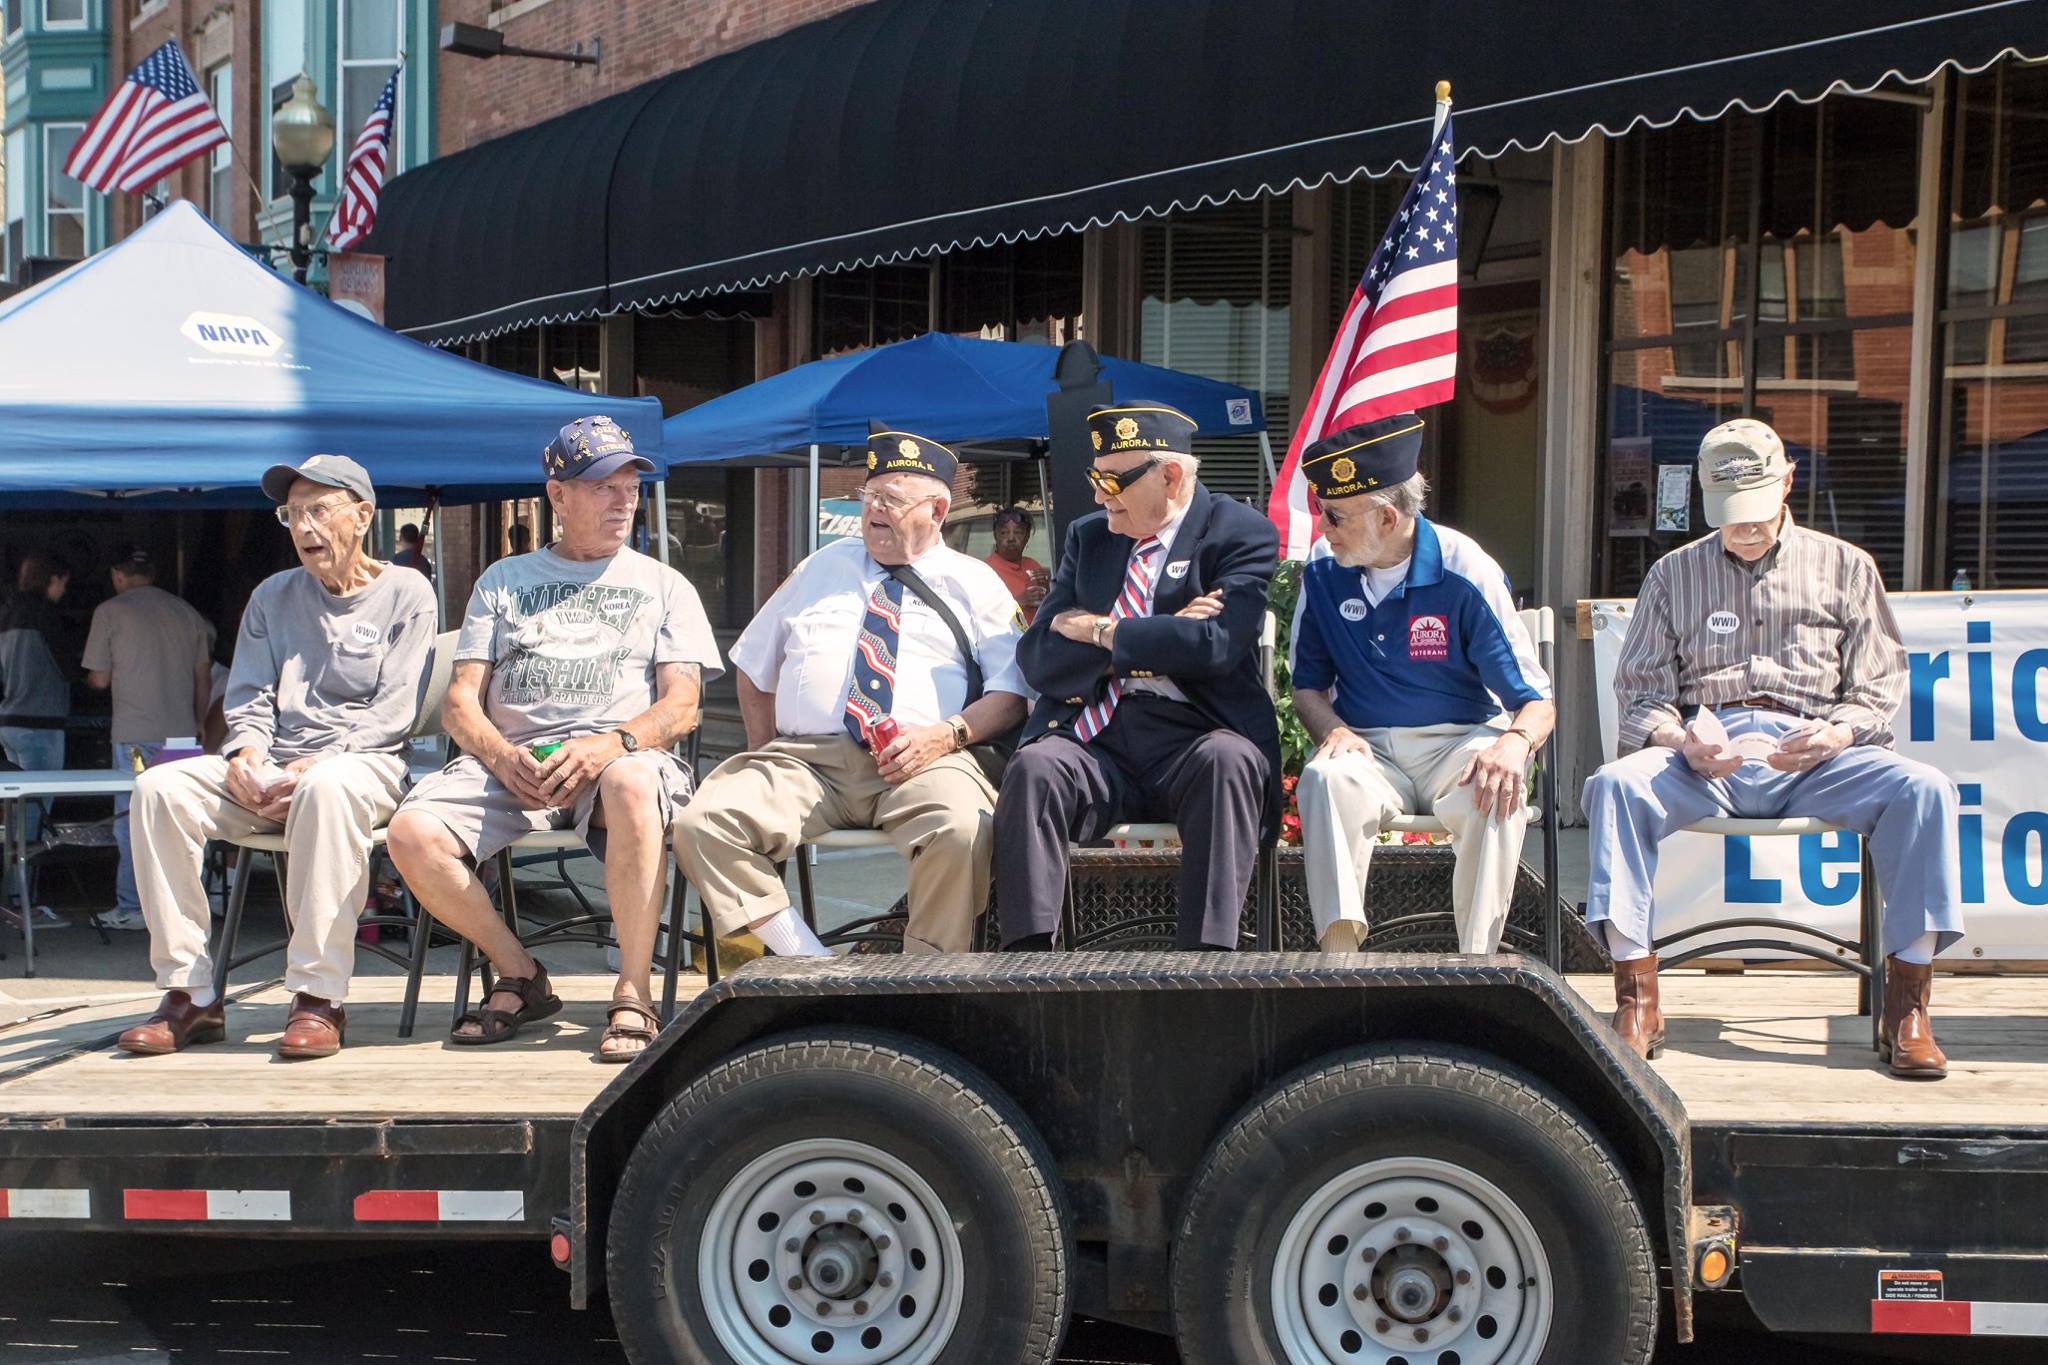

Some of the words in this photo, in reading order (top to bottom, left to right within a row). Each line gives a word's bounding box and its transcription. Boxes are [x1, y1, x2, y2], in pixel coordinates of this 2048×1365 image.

[197, 324, 270, 347] NAPA
[1111, 438, 1151, 451] AURORA,
[1156, 438, 1169, 447] ILL
[886, 459, 926, 471] AURORA,
[927, 463, 935, 472] IL
[1326, 481, 1367, 496] AURORA,
[1368, 477, 1378, 486] IL
[603, 599, 631, 611] KOREA
[1344, 603, 1366, 617] WWII
[1711, 616, 1737, 628] WWII
[355, 624, 378, 640] WWII
[1410, 630, 1446, 643] AURORA
[1409, 649, 1447, 657] VETERANS
[551, 689, 612, 706] GRANDKIDS
